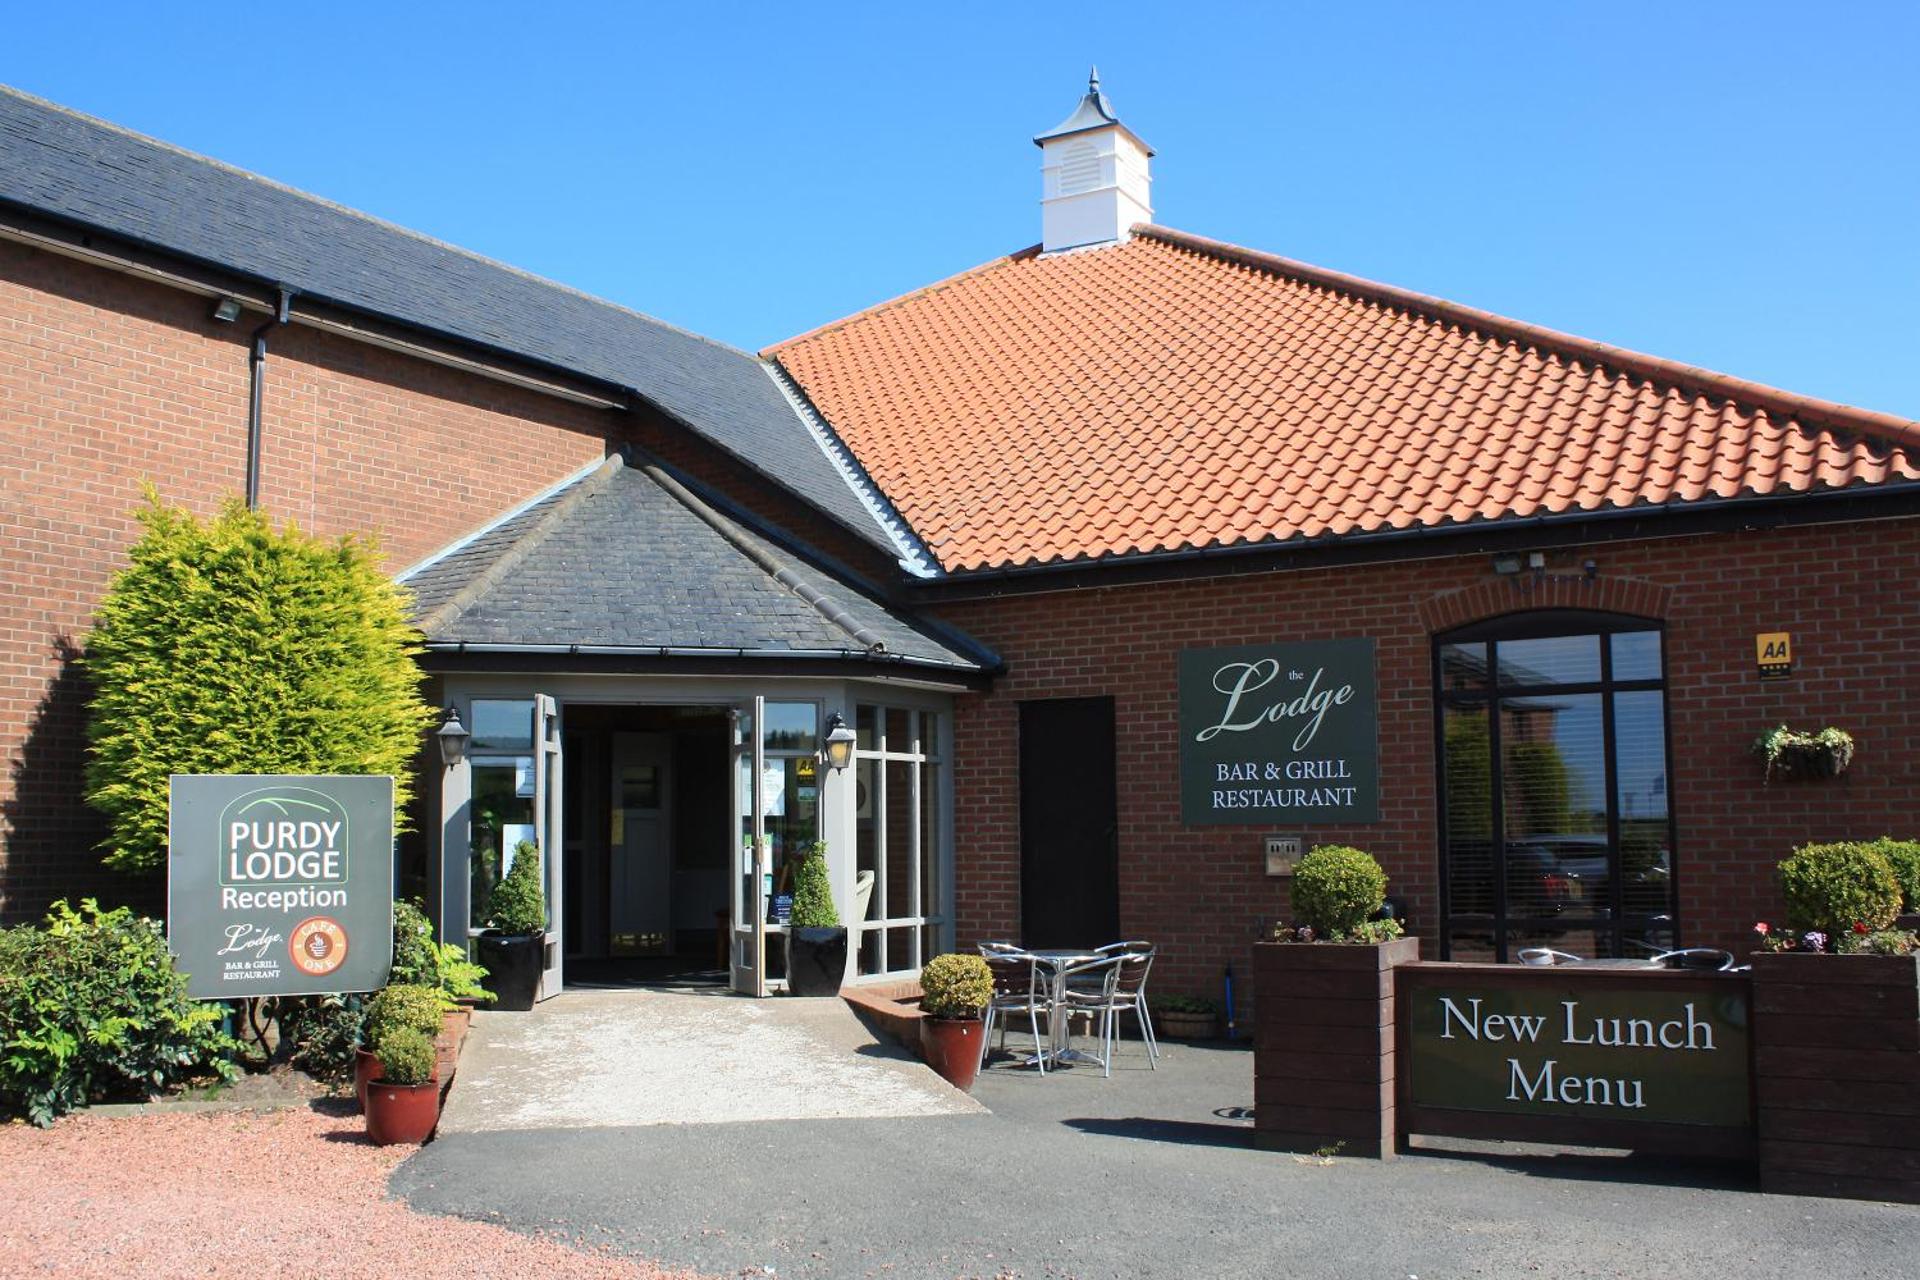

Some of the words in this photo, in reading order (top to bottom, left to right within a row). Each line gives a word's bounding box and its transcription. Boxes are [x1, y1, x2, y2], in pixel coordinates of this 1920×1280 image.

[1763, 641, 1787, 658] AA
[1288, 670, 1305, 680] the
[1195, 658, 1355, 752] Lodge
[1216, 762, 1260, 782] BAR
[1264, 762, 1281, 781] &
[1285, 759, 1351, 779] GRILL
[1212, 787, 1357, 809] RESTAURANT
[231, 821, 341, 850] PURDY
[231, 851, 340, 880] LODGE
[222, 886, 347, 912] Reception
[217, 923, 282, 959] Lodge
[223, 970, 281, 980] RESTAURANT
[225, 962, 244, 970] BAR
[245, 961, 252, 970] &
[252, 960, 279, 969] GRILL
[1439, 997, 1547, 1043] New
[1561, 1001, 1717, 1050] Lunch
[1505, 1058, 1647, 1109] Menu
